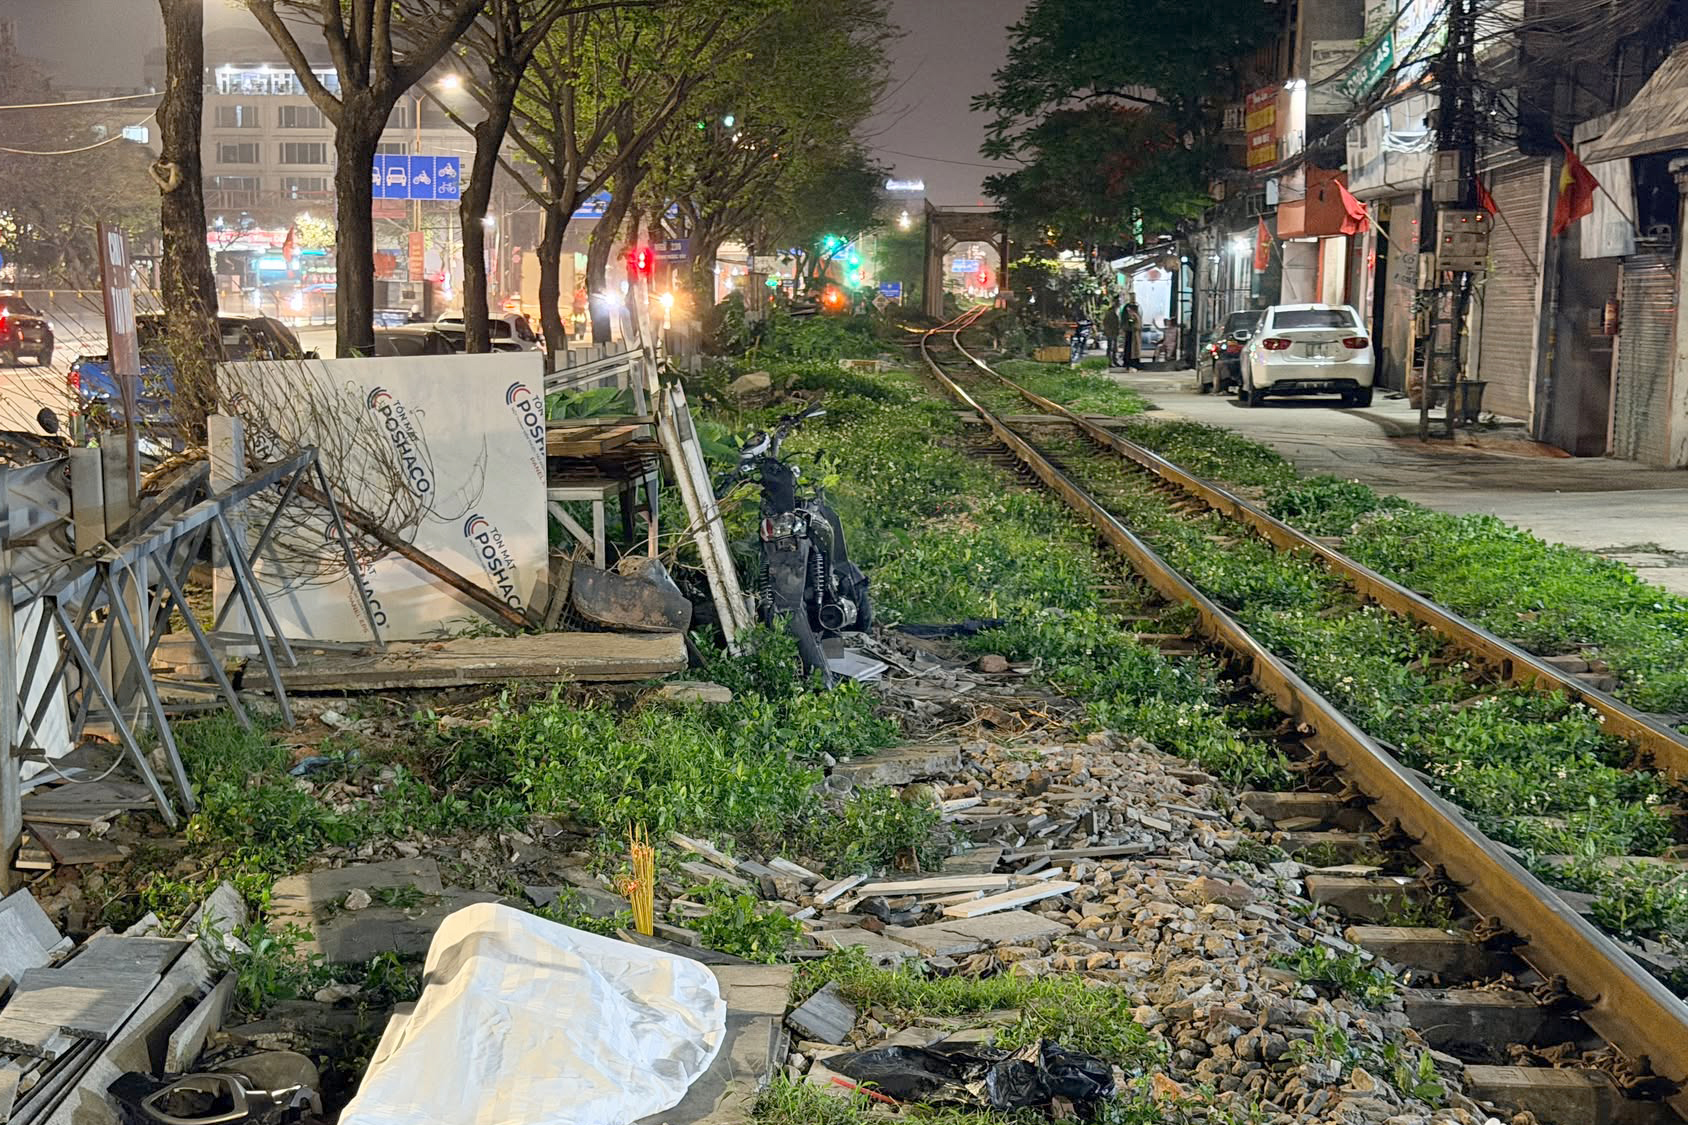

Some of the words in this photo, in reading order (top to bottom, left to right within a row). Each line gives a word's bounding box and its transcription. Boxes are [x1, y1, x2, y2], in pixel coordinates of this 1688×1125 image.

[393, 400, 407, 422] TÔN
[378, 404, 430, 493] POSHACO
[490, 527, 504, 549] TÔN
